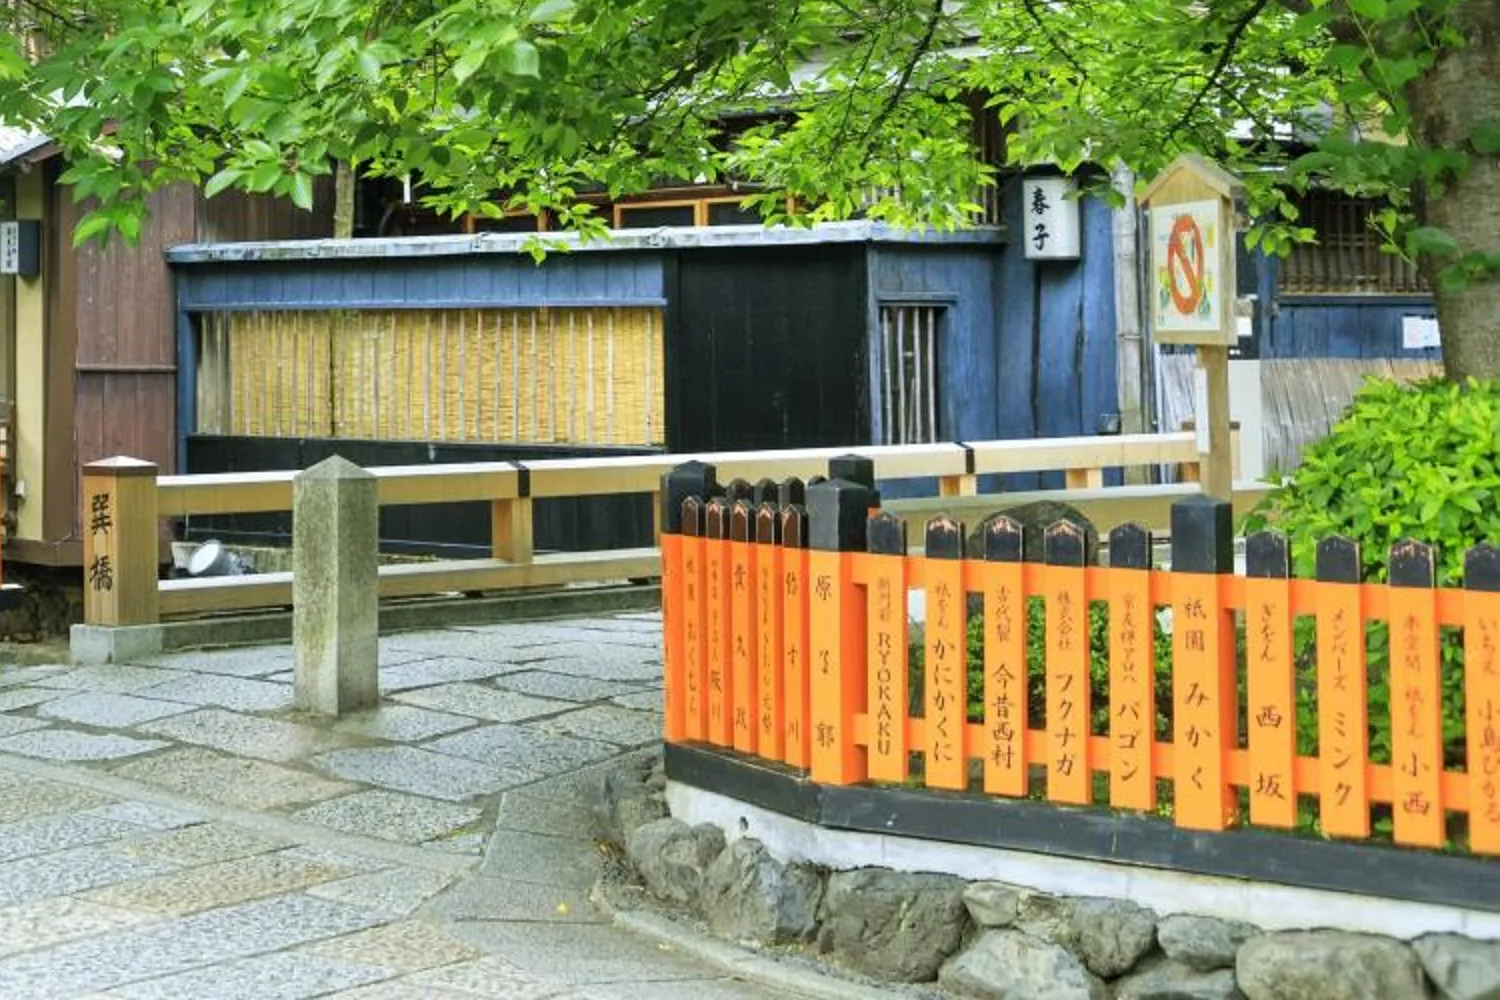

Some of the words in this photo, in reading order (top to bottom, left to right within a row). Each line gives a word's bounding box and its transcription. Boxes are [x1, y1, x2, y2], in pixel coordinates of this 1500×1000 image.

[1031, 188, 1050, 251] 春子
[89, 493, 113, 592] 巽橋
[1184, 596, 1206, 652] 祇園
[876, 632, 891, 756] RYOKAKU
[932, 637, 956, 762] かにかくに
[991, 663, 1016, 770] 今昔西村
[1054, 673, 1077, 777] フクナガ
[1114, 700, 1142, 782] パゴン
[1184, 681, 1211, 790] みかく
[1255, 704, 1286, 801] 西坂
[1332, 711, 1353, 808] ミンク
[1400, 751, 1430, 815] 小西
